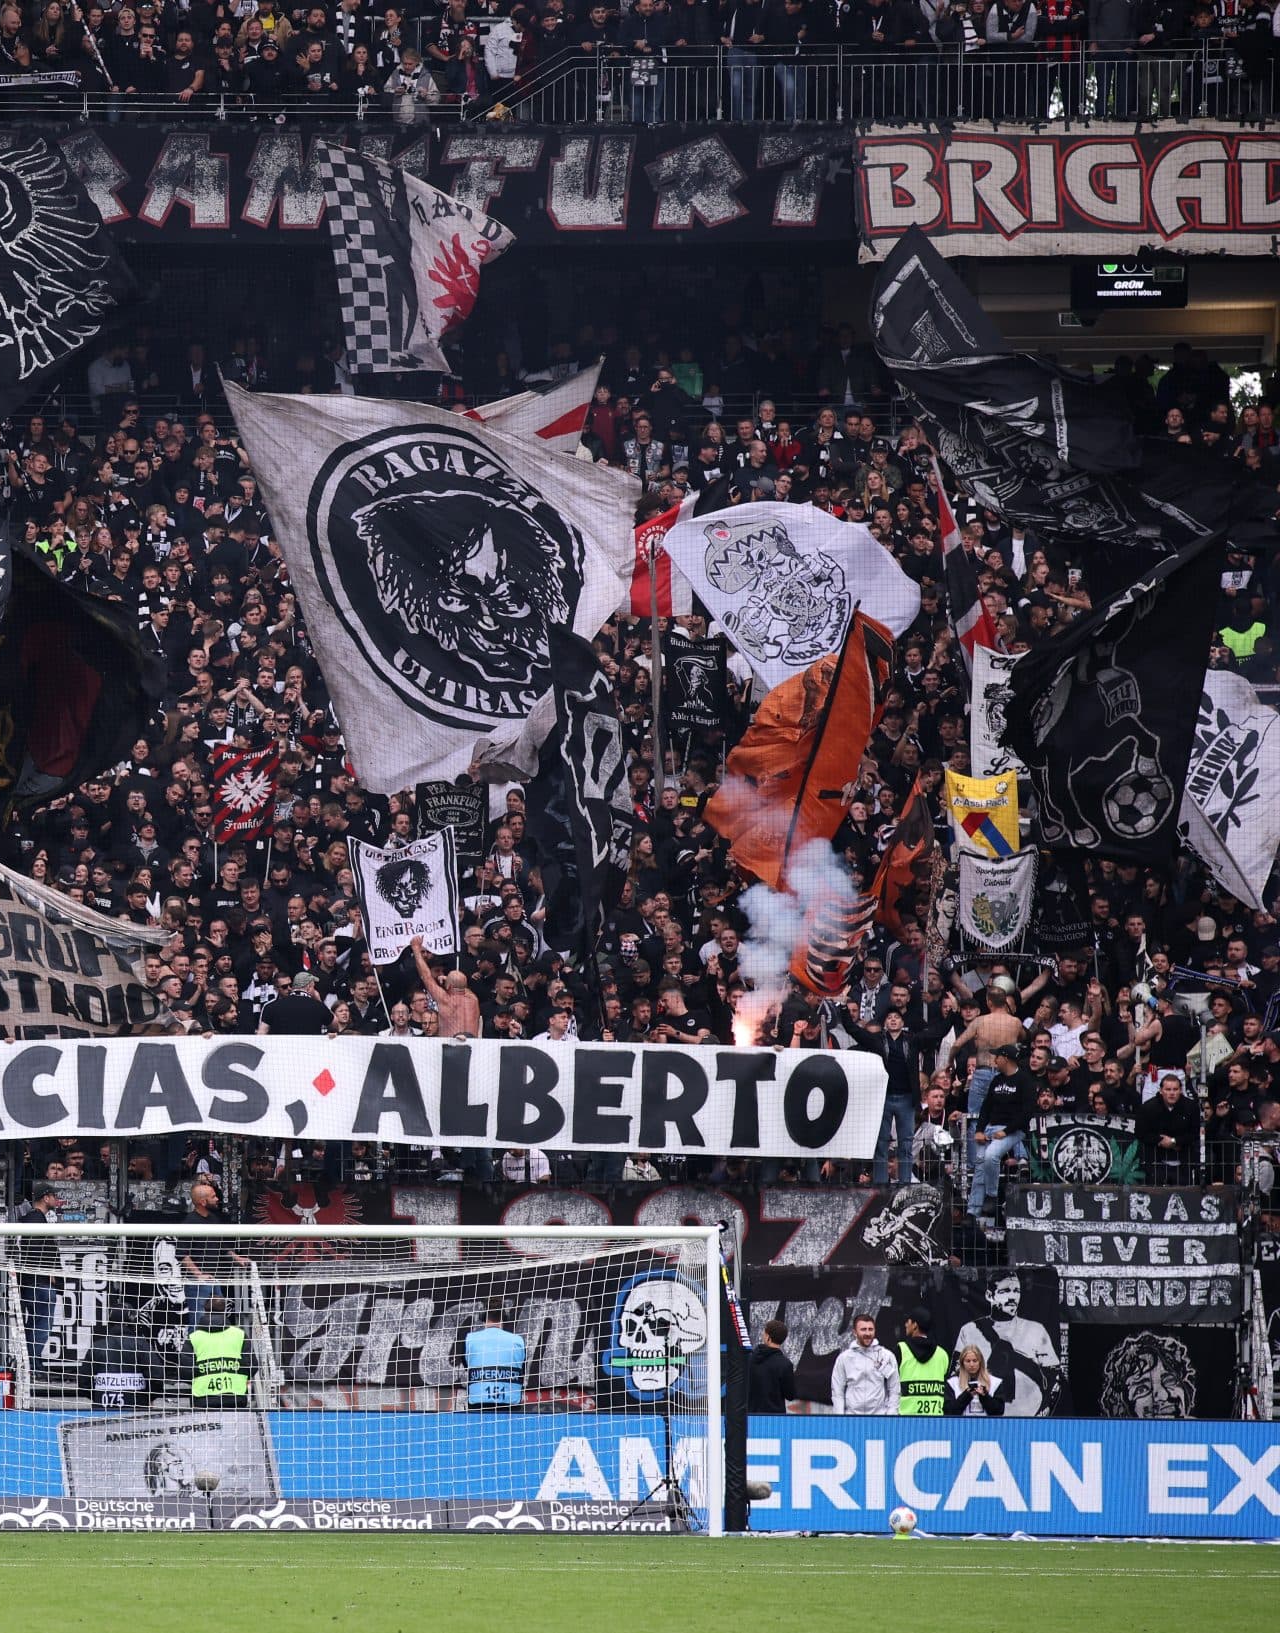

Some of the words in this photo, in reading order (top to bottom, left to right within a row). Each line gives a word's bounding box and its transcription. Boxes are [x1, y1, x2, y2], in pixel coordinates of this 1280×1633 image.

[1114, 279, 1145, 290] GRÜN
[392, 646, 538, 715] ULTRAS
[425, 794, 482, 810] FRANKFURT
[353, 1043, 849, 1148] ALBERTO
[1026, 1190, 1221, 1222] ULTRAS
[1043, 1233, 1208, 1264] NEVER
[1058, 1278, 1233, 1308] RRENDER
[198, 1360, 241, 1374] STEWARD
[101, 1393, 125, 1407] 075
[105, 1428, 164, 1442] AMERICAN
[170, 1422, 222, 1435] EXPRESS
[1148, 1442, 1280, 1516] EX
[76, 1498, 154, 1512] Deutsche
[313, 1499, 391, 1513] Deutsche
[550, 1501, 629, 1515] Deutsche
[76, 1512, 195, 1529] Dienstrad
[313, 1513, 432, 1530] Dienstrad
[550, 1515, 671, 1532] Dienstrad
